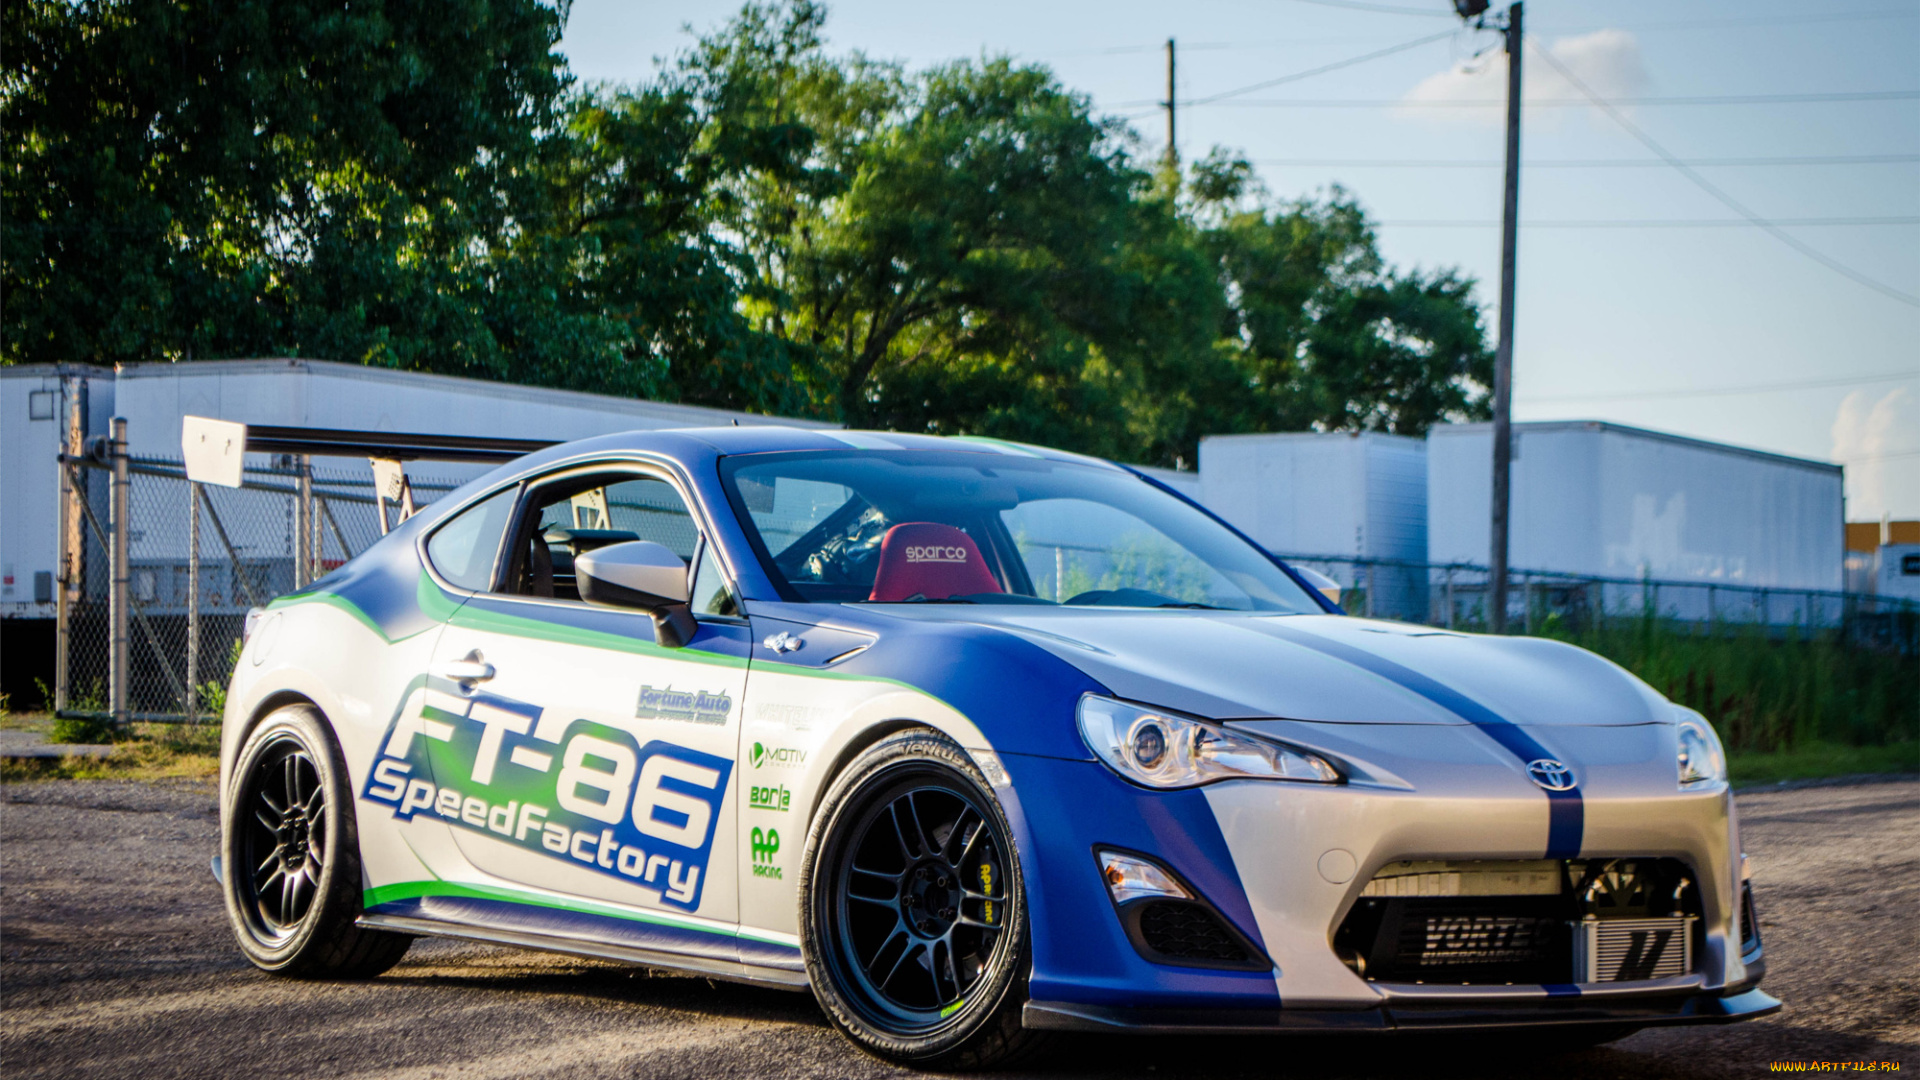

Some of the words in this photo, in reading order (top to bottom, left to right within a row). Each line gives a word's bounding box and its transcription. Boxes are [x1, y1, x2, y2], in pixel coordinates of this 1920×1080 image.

[905, 545, 967, 562] sparco
[638, 686, 694, 710] Fortune
[695, 691, 732, 714] Auto
[384, 687, 721, 850] FT-86
[765, 746, 808, 763] MOTIV
[369, 760, 699, 904] SpeedFactory
[751, 826, 780, 864] AP
